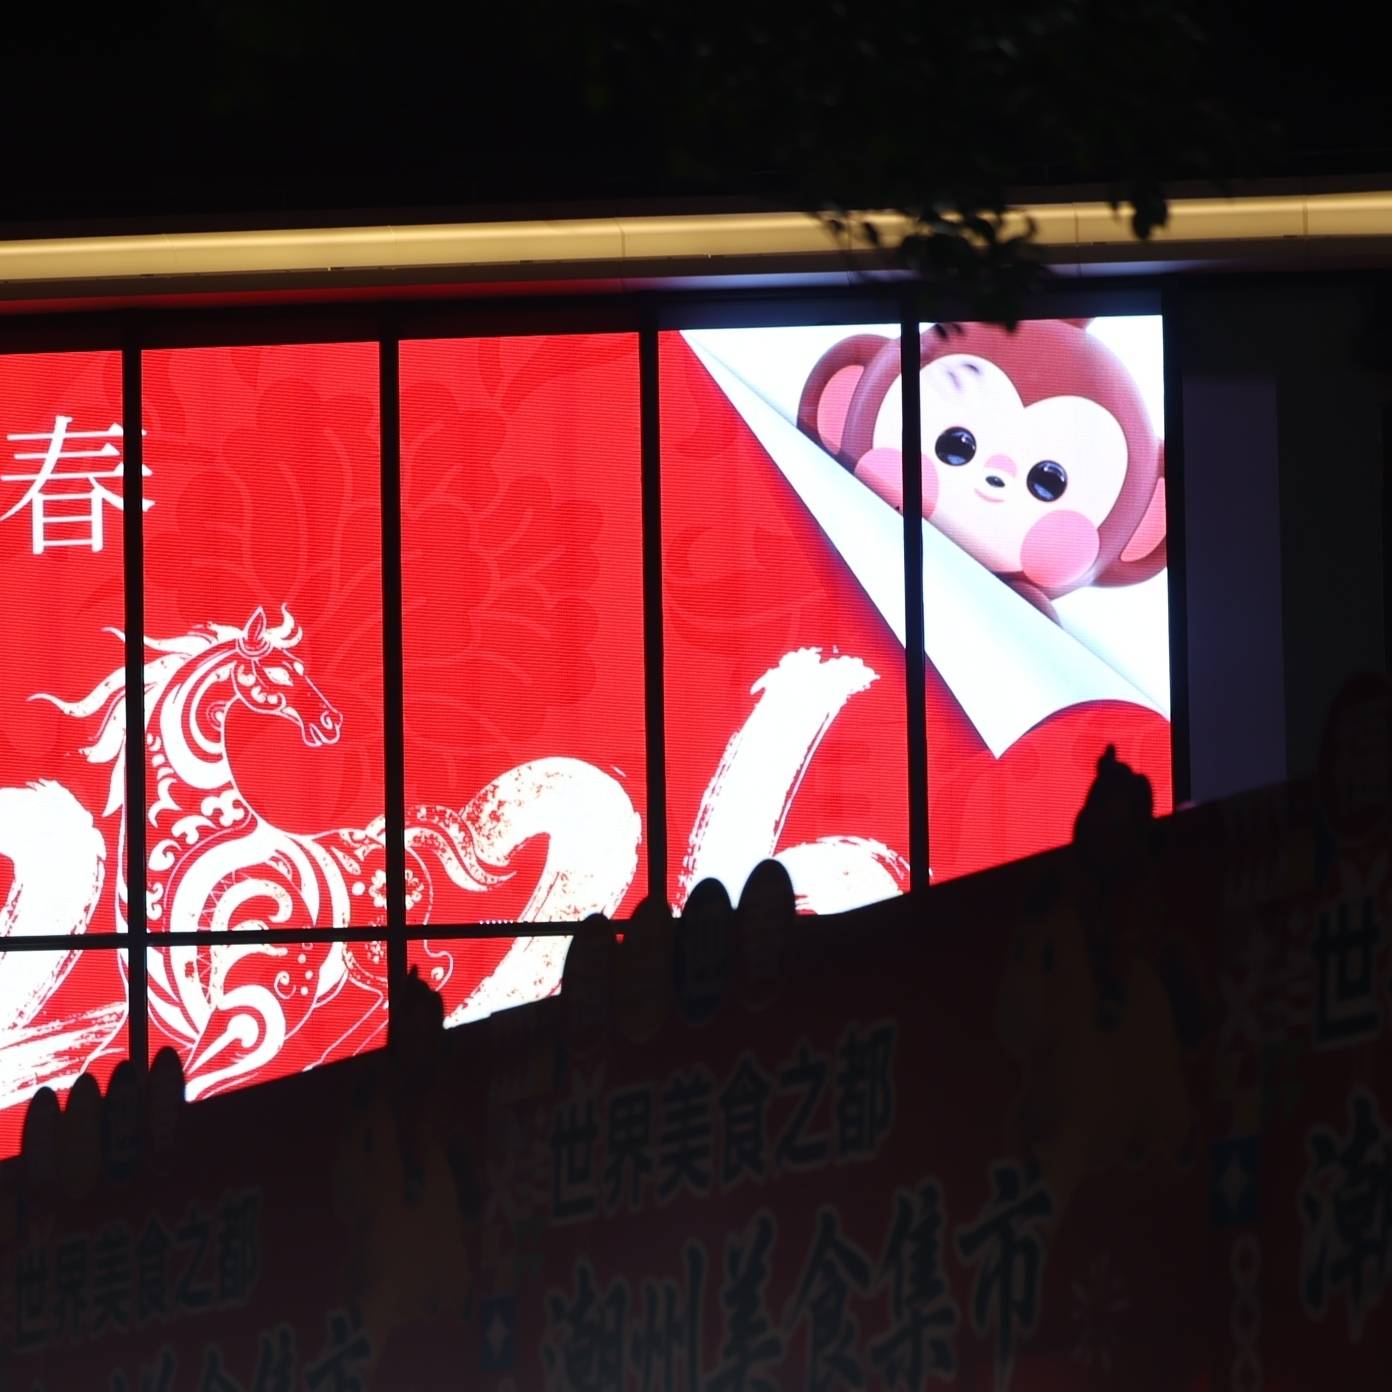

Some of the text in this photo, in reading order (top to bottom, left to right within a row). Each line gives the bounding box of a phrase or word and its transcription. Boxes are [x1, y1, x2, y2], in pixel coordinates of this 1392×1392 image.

[548, 1017, 897, 1225] 世界美食之都
[14, 1186, 263, 1354] 世界美食之都
